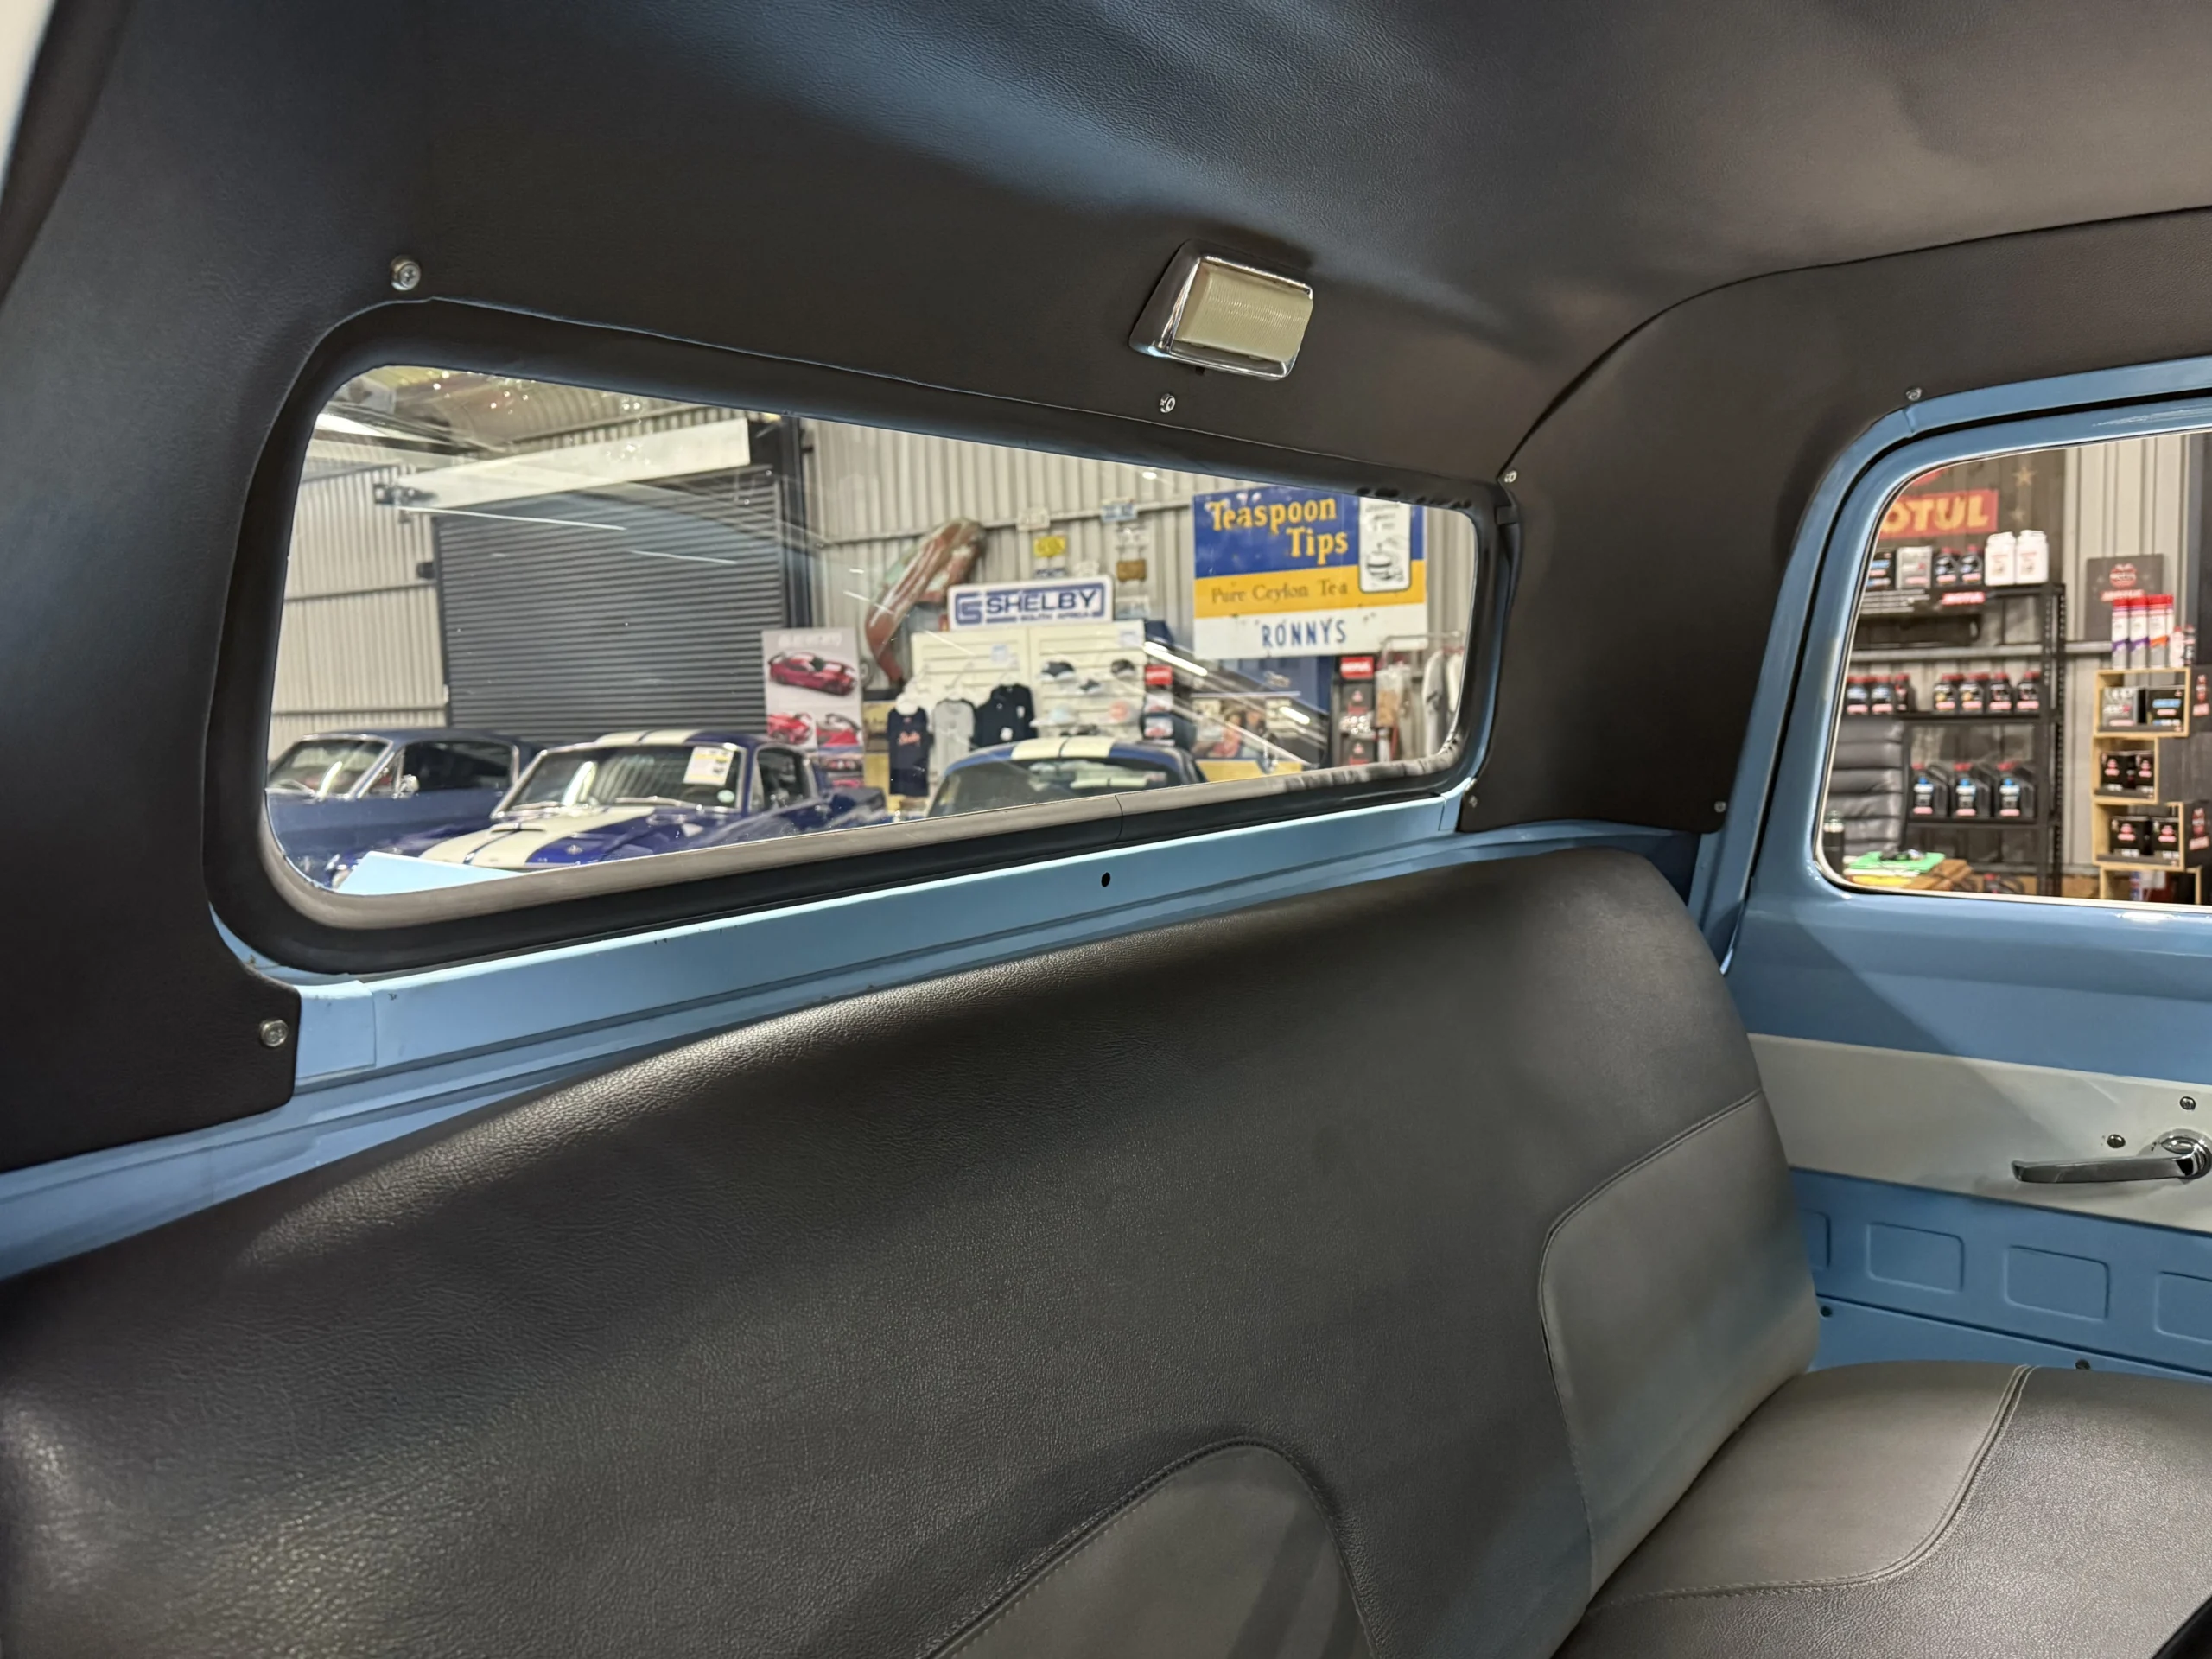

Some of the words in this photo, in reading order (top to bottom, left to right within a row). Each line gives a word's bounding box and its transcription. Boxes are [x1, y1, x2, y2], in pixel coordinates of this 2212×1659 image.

[1210, 498, 1337, 535] Teaspoon
[1880, 494, 1989, 533] OTUL
[1286, 526, 1349, 565] Tips
[986, 589, 1097, 614] SHELBY
[1211, 587, 1246, 604] Pure
[1252, 582, 1310, 602] Ceylon
[1318, 579, 1349, 597] Tea
[1262, 618, 1346, 648] RONNYS
